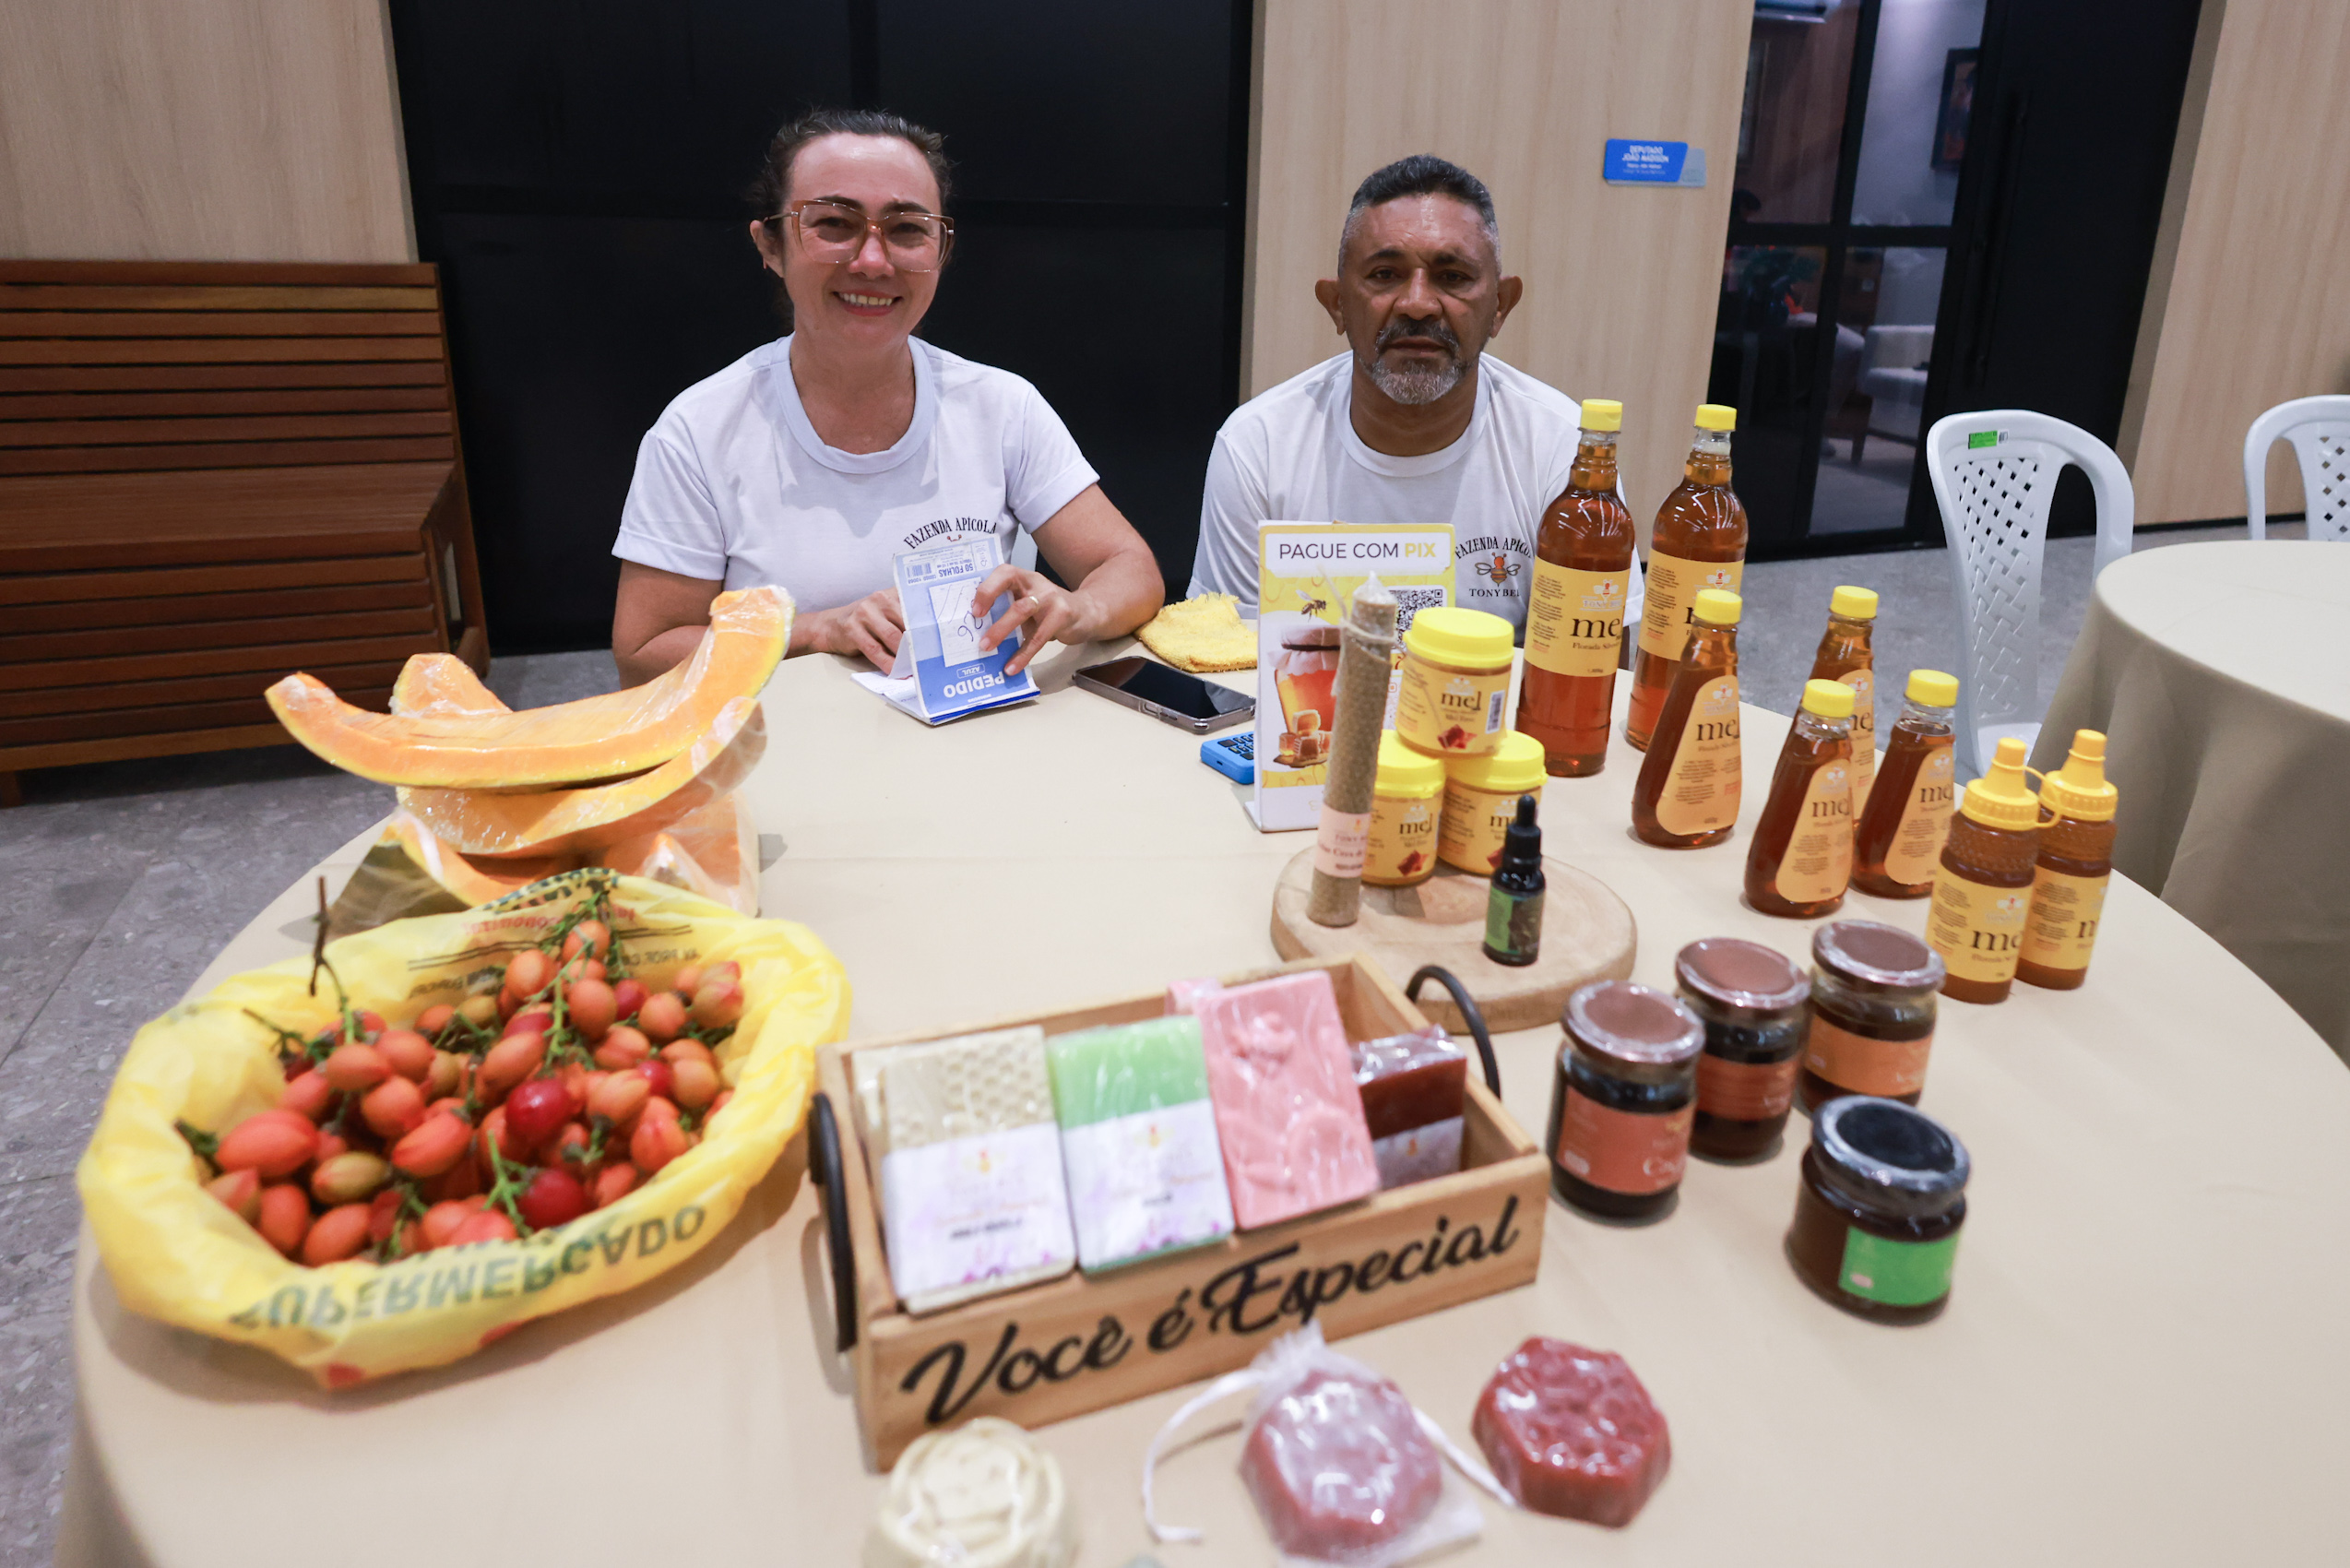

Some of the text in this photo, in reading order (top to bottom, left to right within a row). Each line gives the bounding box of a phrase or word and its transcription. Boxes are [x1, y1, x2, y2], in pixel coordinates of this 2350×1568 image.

[904, 519, 953, 550] FAZENDA
[1279, 542, 1437, 559] PAGUE COM PIX
[1455, 536, 1499, 559] FAZENDA
[939, 564, 964, 577] FOLHAS
[966, 563, 973, 572] 50
[1469, 588, 1520, 597] TONY BE
[1570, 616, 1622, 640] me
[962, 666, 980, 676] AZUL
[944, 671, 1005, 698] PEDIDO
[1441, 691, 1482, 711] mel
[900, 1195, 1520, 1425] Você é Especial
